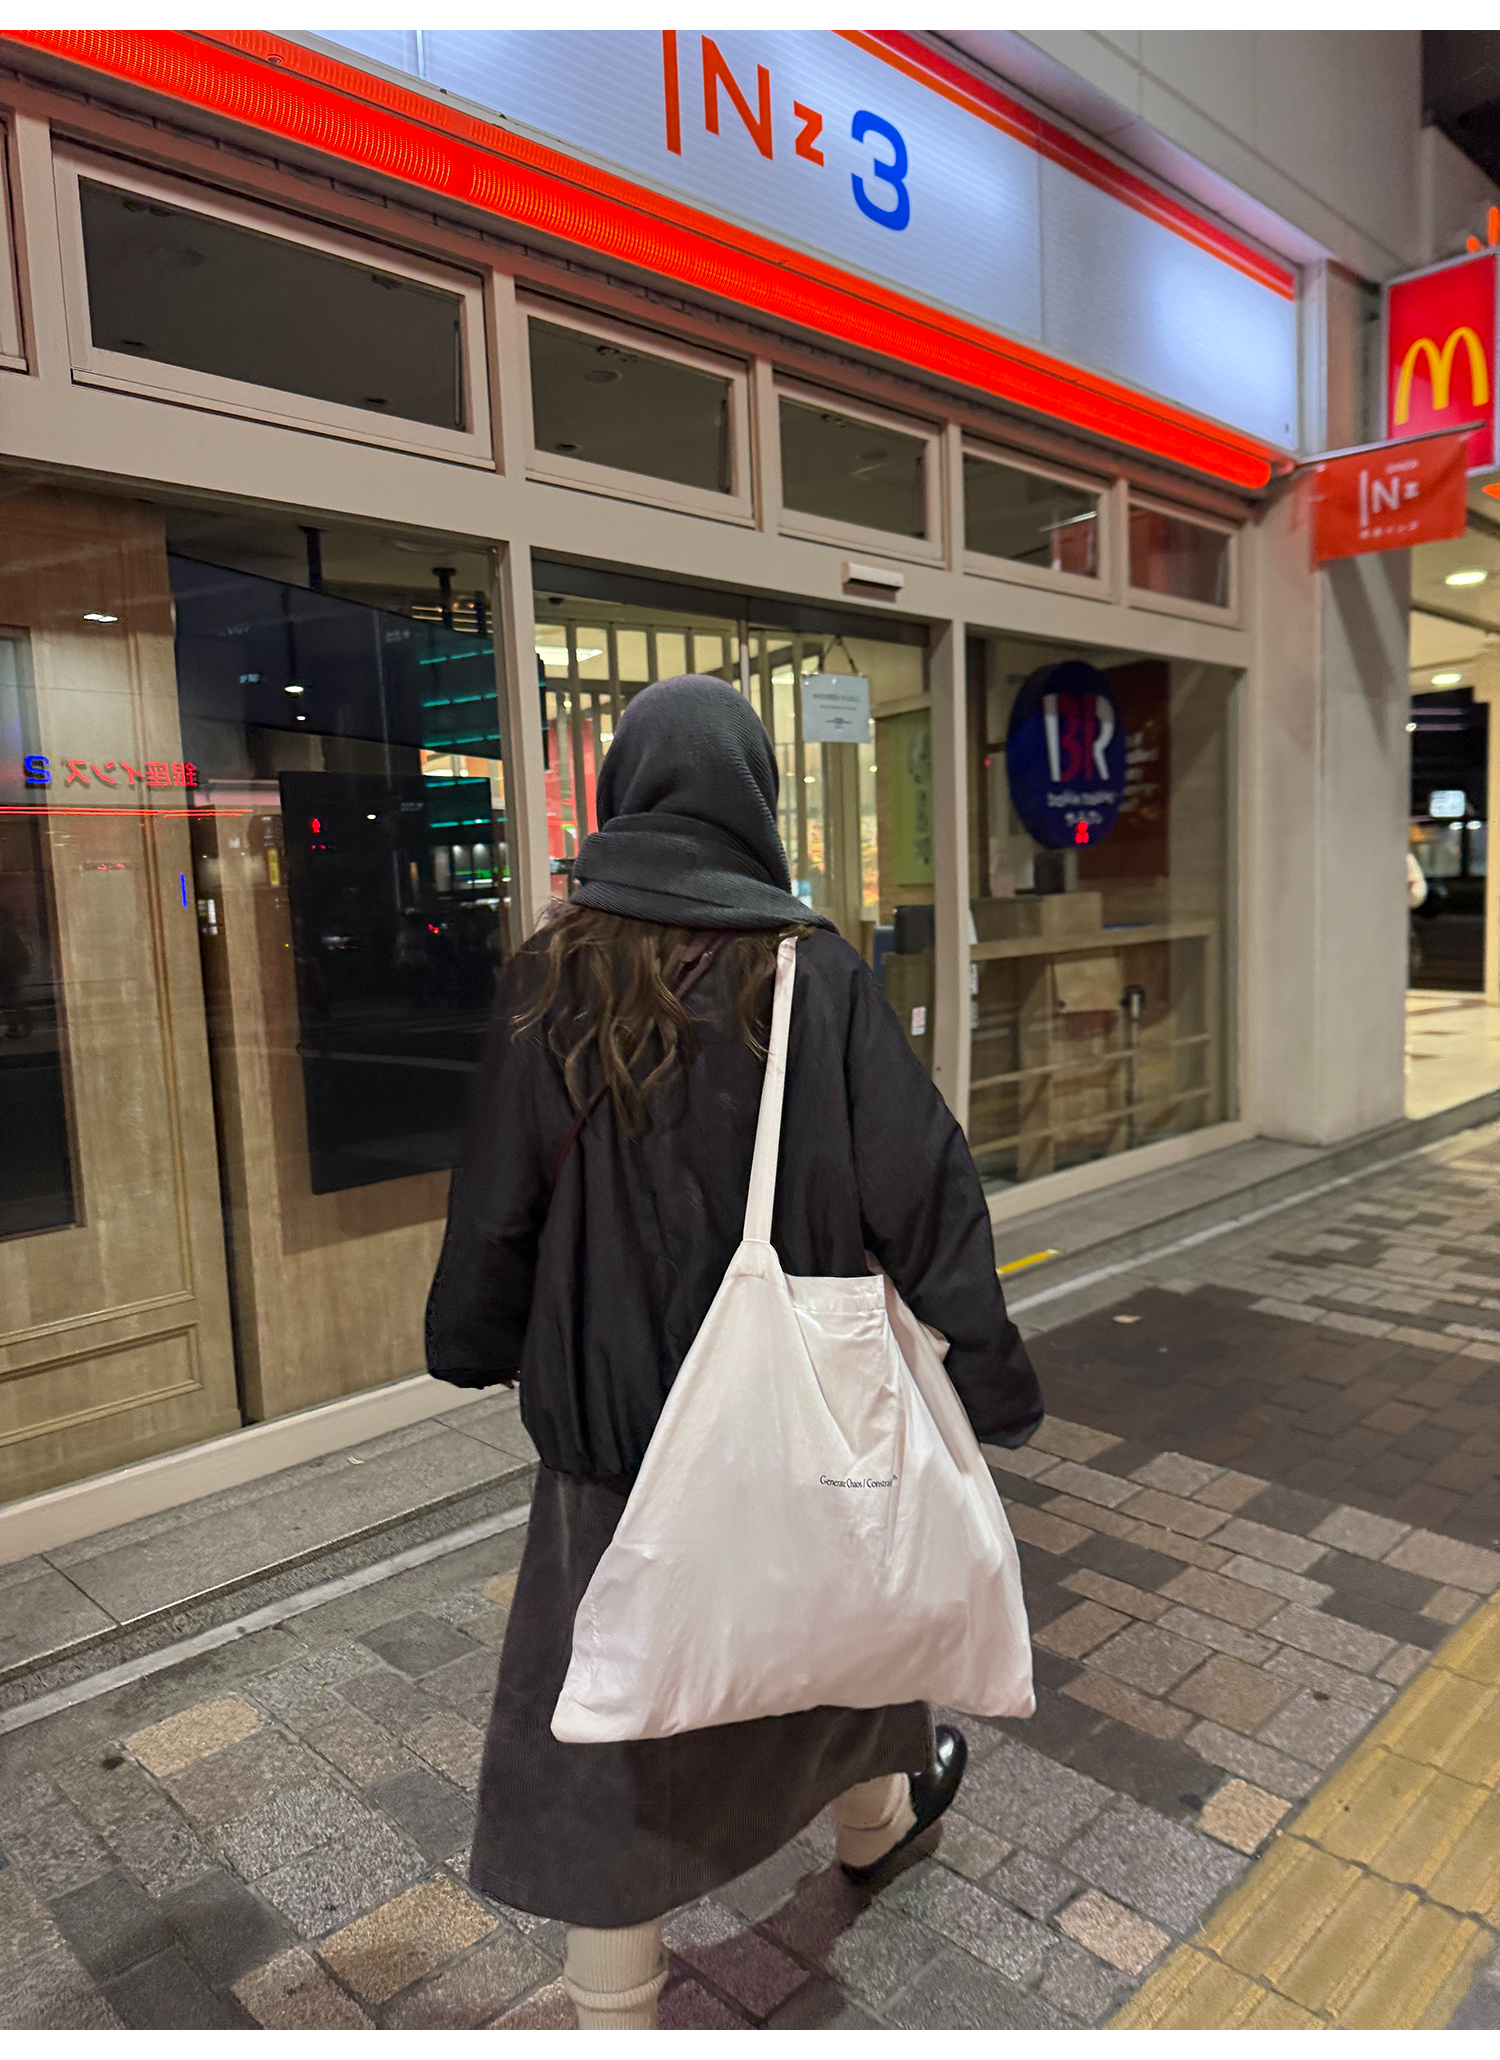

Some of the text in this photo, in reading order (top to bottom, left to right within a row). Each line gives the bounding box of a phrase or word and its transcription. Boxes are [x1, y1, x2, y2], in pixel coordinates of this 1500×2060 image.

[851, 109, 911, 232] 3
[820, 1474, 846, 1488] Generate
[846, 1478, 862, 1488] Chaos
